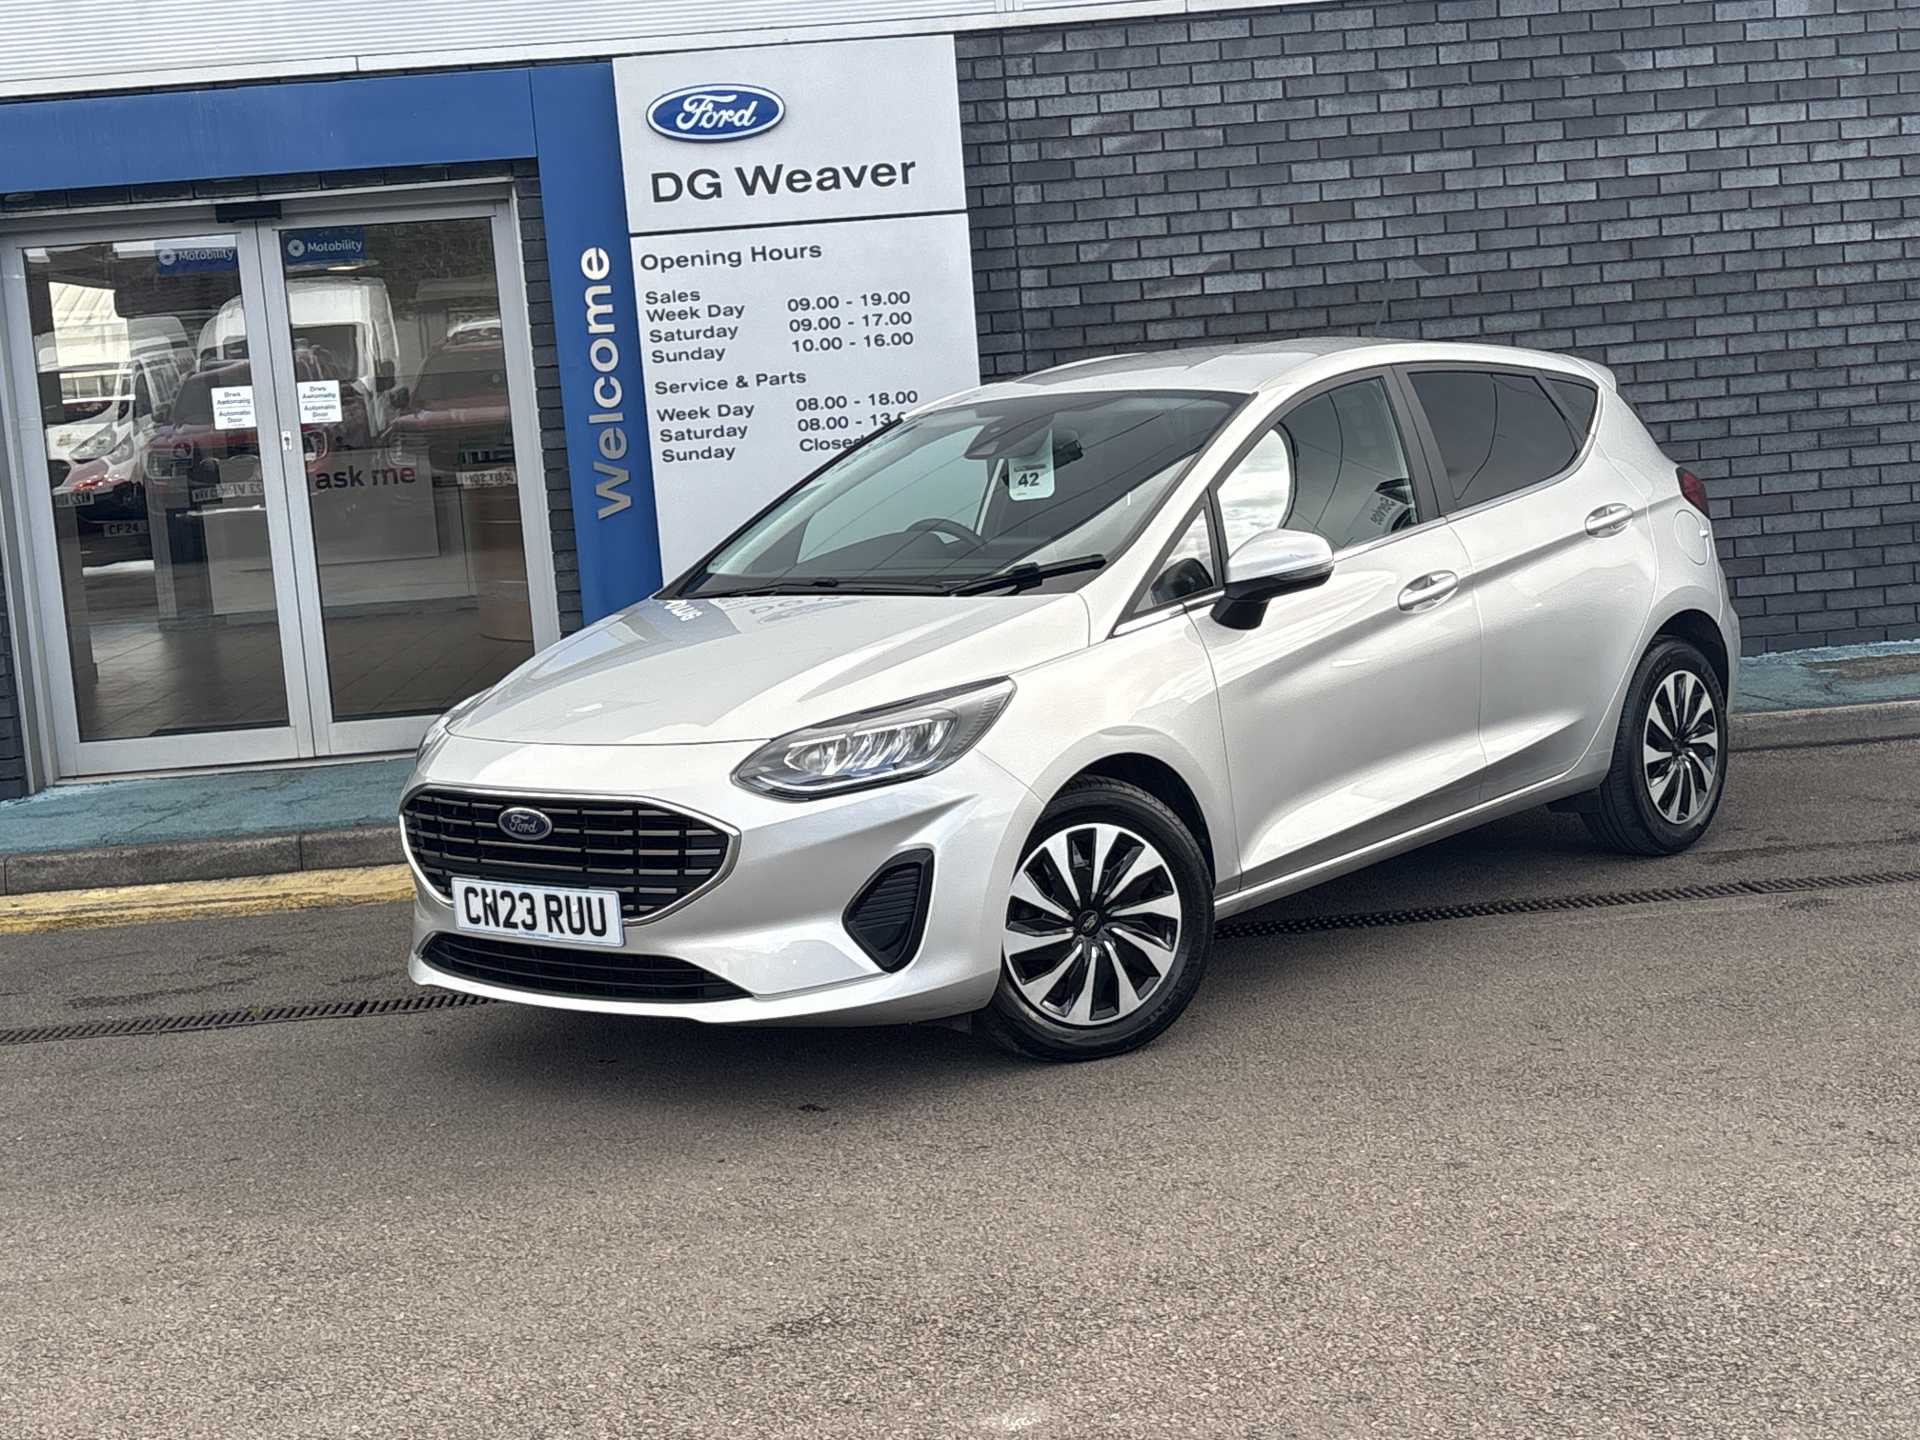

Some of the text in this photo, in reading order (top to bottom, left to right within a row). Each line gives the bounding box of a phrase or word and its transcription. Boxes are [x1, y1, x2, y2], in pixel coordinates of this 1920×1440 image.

[676, 94, 757, 130] Ford
[651, 160, 917, 203] DG Weaver
[640, 245, 822, 273] Opening Hours
[645, 290, 701, 305] Sales
[646, 307, 701, 322] Week
[707, 304, 745, 319] Day
[787, 295, 839, 312] 09.00
[860, 291, 911, 307] 19.00
[649, 325, 739, 343] Saturday
[788, 316, 841, 332] 09.00
[861, 311, 912, 327] 17.00
[651, 346, 726, 364] Sunday
[792, 337, 843, 353] 10.00
[863, 331, 914, 348] 16.00
[580, 247, 632, 520] Welcome
[654, 371, 807, 395] Service & Parts
[657, 407, 711, 422] Week
[717, 403, 755, 419] Day
[796, 395, 847, 412] 08.00
[868, 390, 918, 407] 18.00
[660, 424, 748, 443] Saturday
[797, 416, 849, 432] 08.00
[661, 445, 736, 463] Sunday
[315, 465, 416, 489] ask me
[1018, 472, 1040, 488] 42
[509, 814, 538, 833] Ford
[463, 886, 607, 937] CN23 RUU
